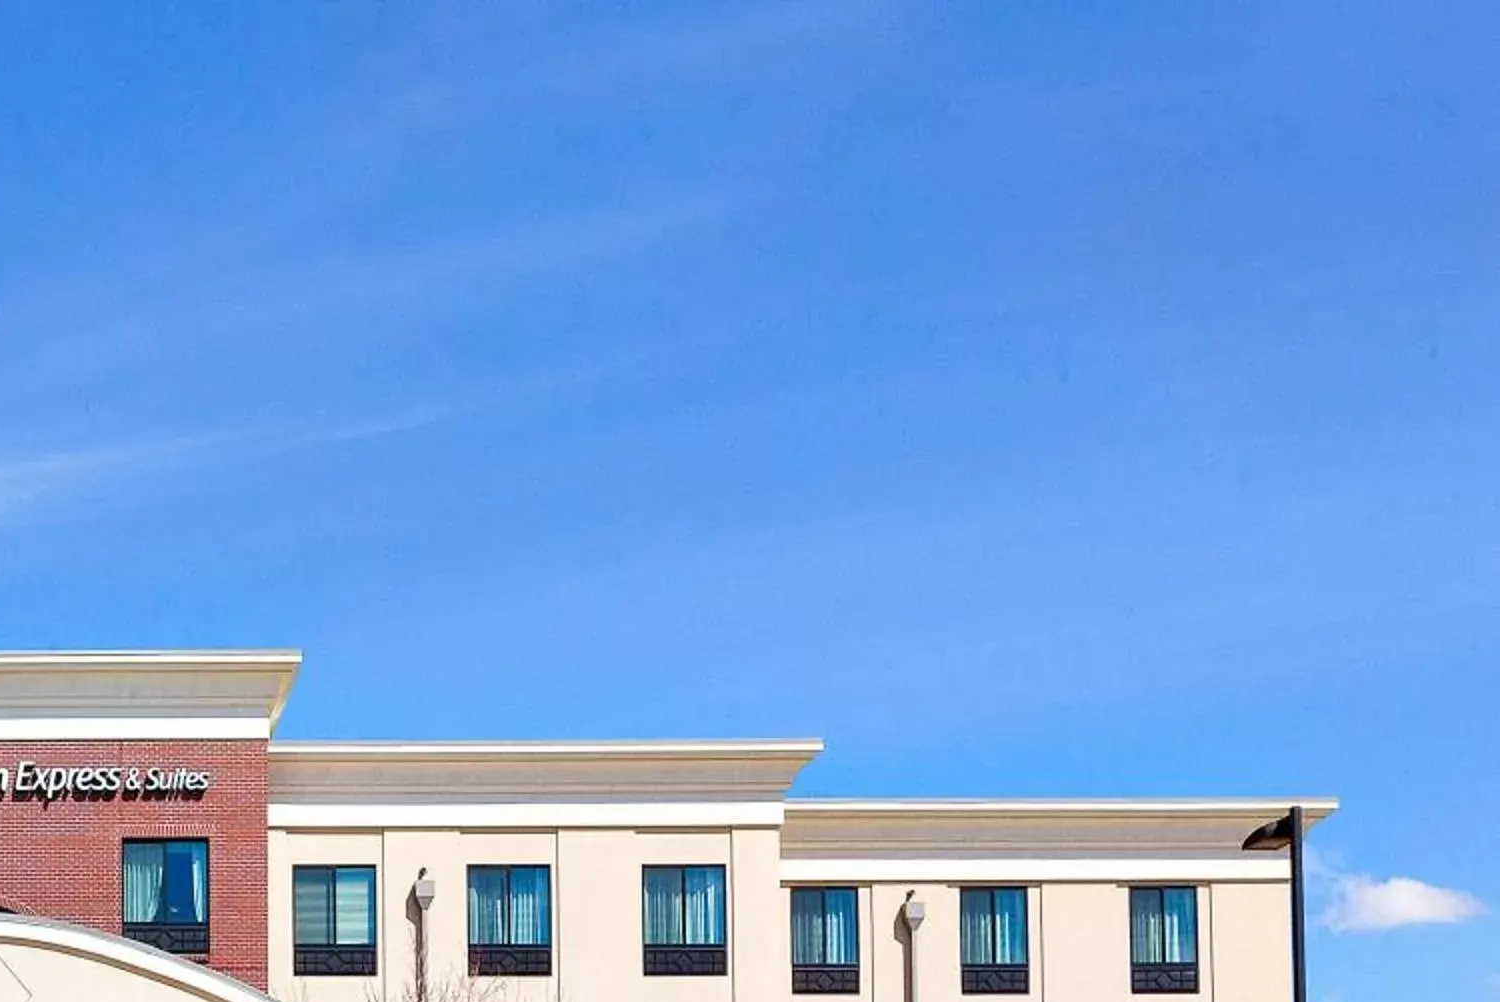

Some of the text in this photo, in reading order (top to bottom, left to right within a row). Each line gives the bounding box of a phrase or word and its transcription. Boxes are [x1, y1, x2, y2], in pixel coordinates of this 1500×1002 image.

[15, 760, 122, 799] Express
[125, 767, 141, 790] &
[145, 767, 209, 790] Suites
